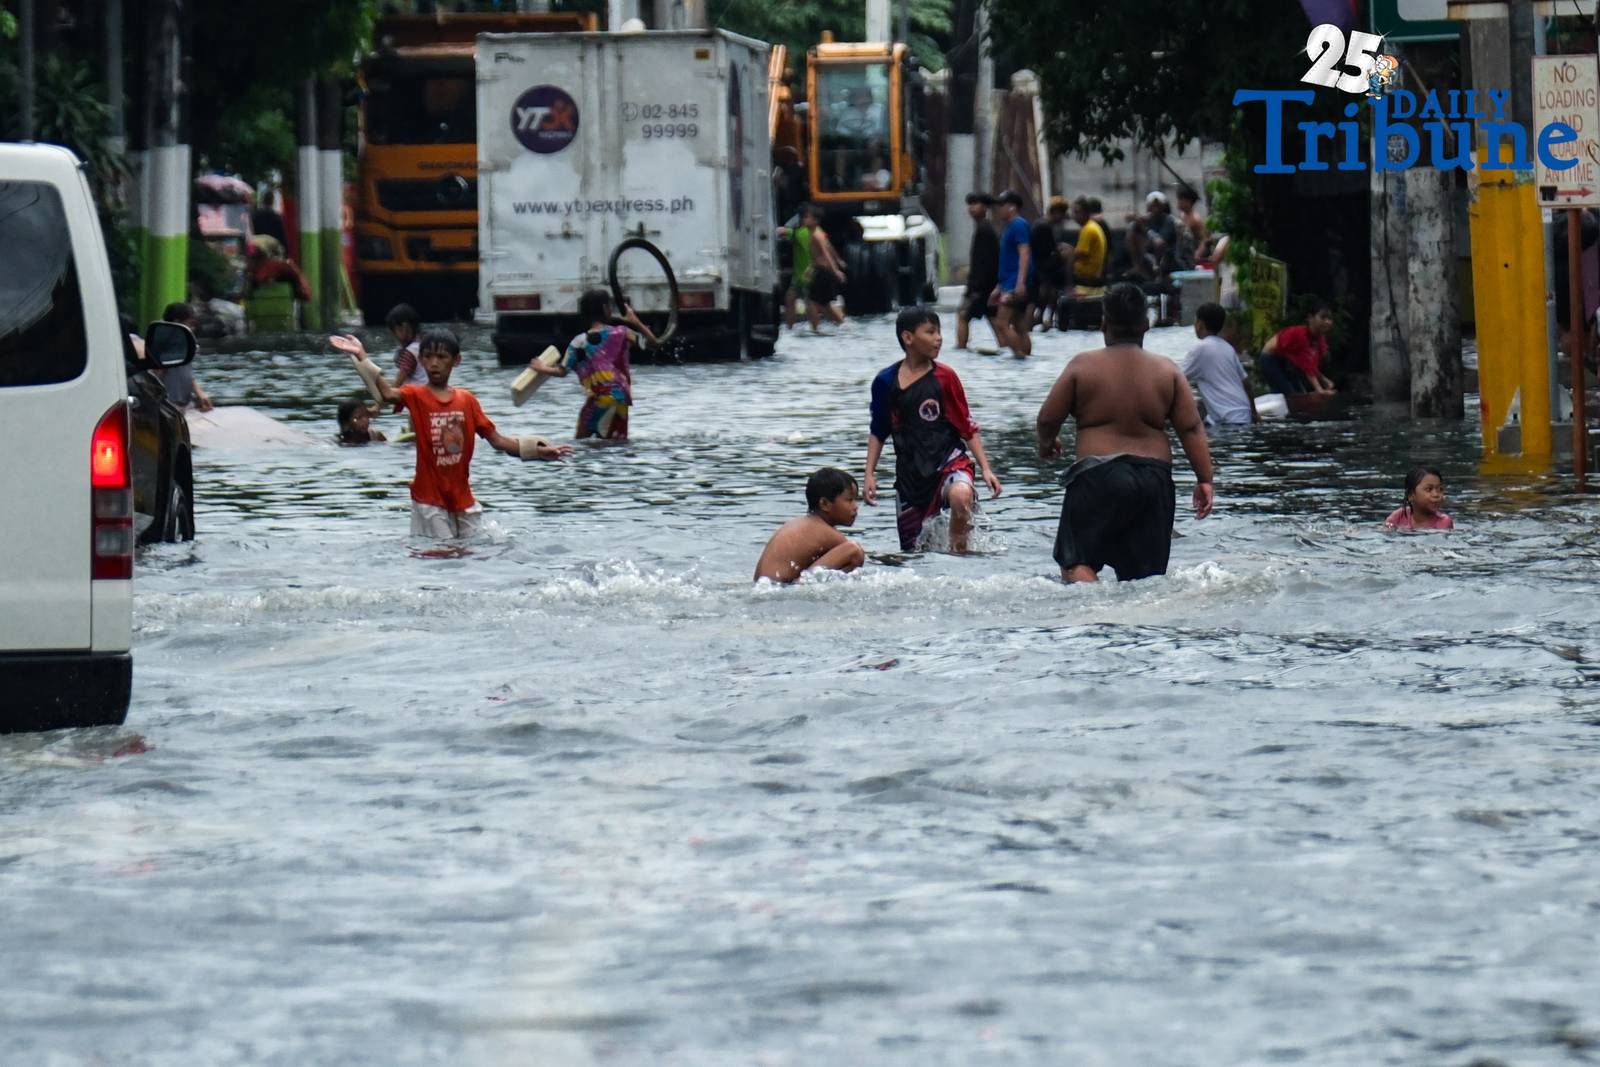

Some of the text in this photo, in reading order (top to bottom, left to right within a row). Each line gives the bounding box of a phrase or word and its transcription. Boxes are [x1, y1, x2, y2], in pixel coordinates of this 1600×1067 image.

[1553, 65, 1577, 84] NO
[1539, 88, 1596, 110] LOADING
[642, 103, 699, 119] 02-845
[642, 123, 699, 139] 99999
[1542, 139, 1597, 157] LOADING
[1545, 163, 1593, 182] ANYTIME
